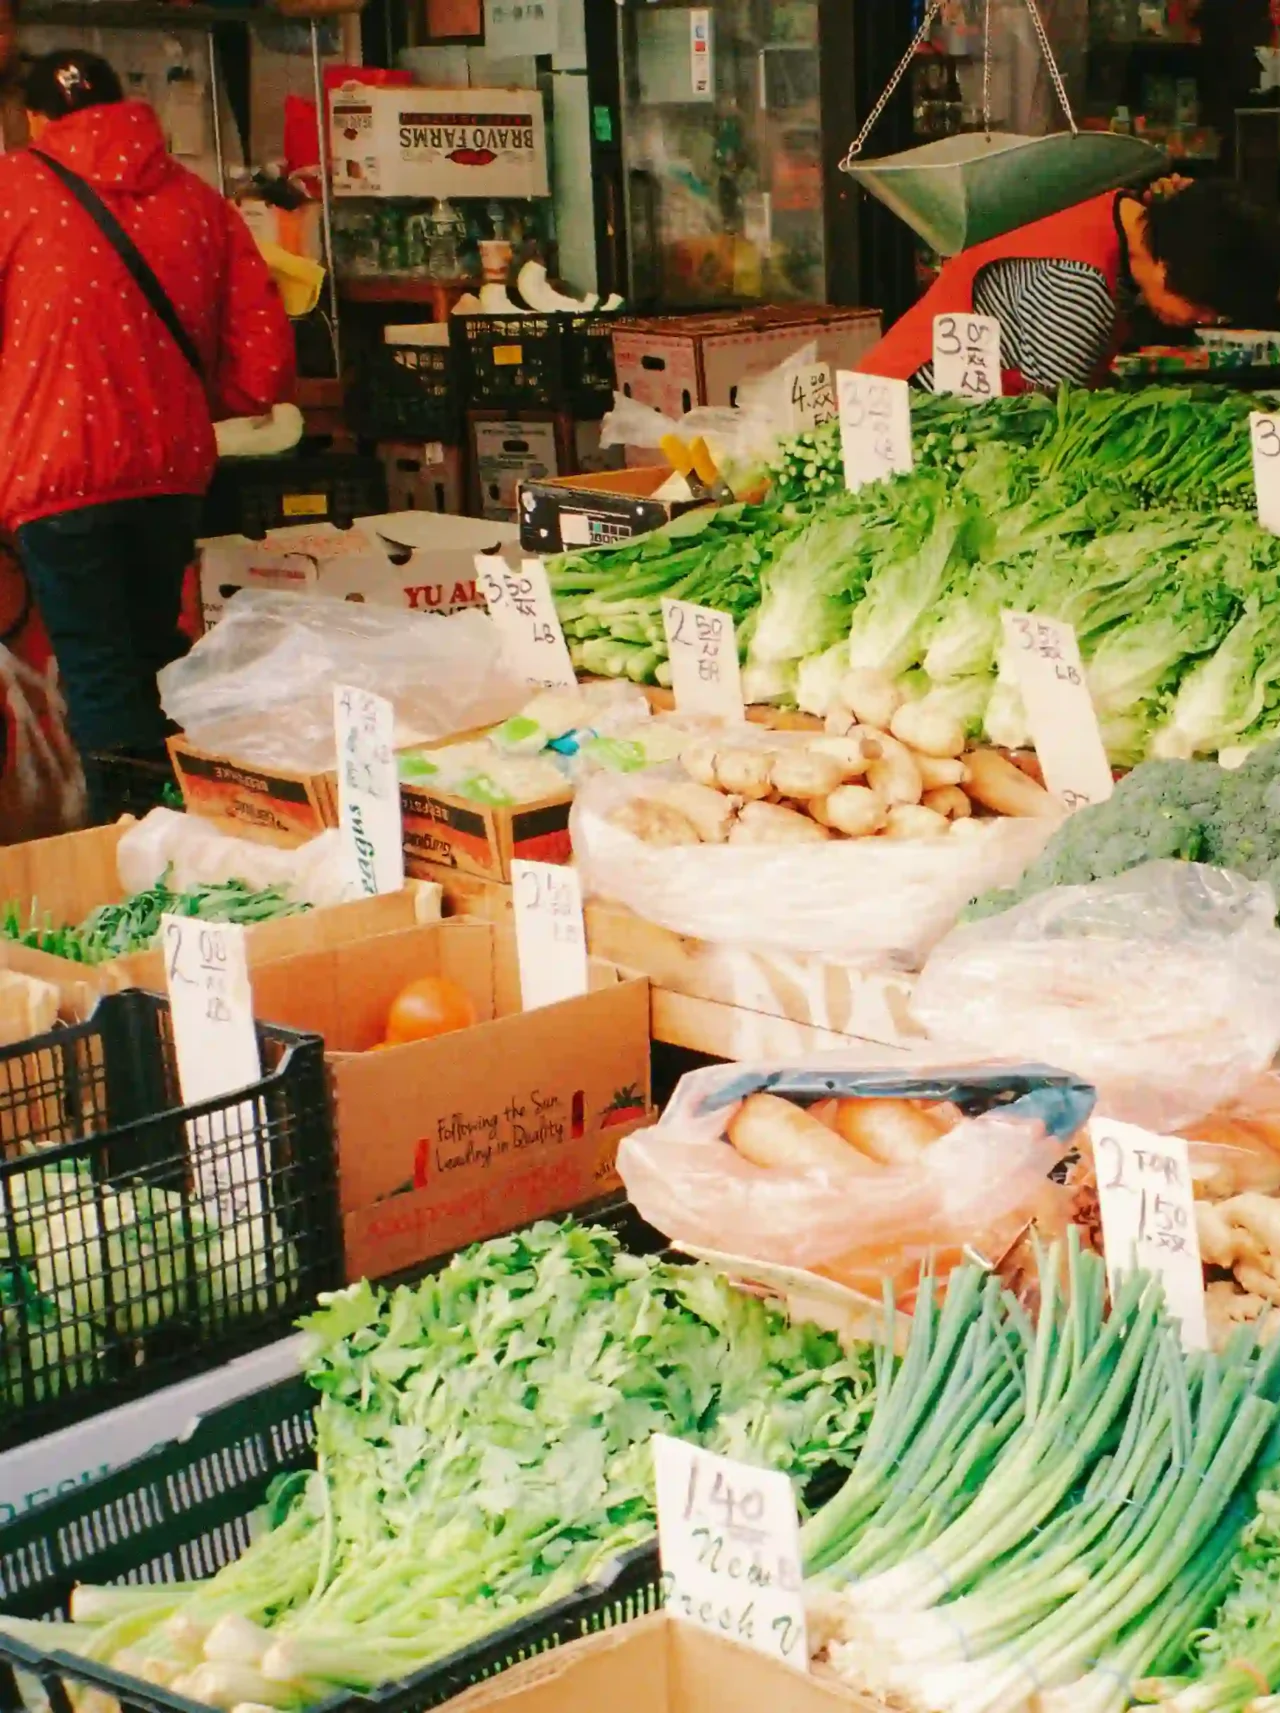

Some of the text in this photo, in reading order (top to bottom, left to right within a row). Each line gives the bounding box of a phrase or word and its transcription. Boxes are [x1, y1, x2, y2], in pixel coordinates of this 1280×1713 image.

[400, 127, 535, 149] BRAVO FARMS
[403, 585, 443, 608] YU
[532, 621, 557, 645] LB
[1055, 663, 1082, 687] LB
[437, 1089, 559, 1143] Following the Sun
[435, 1116, 565, 1173] Leading in Quality
[1099, 1136, 1138, 1194] 2
